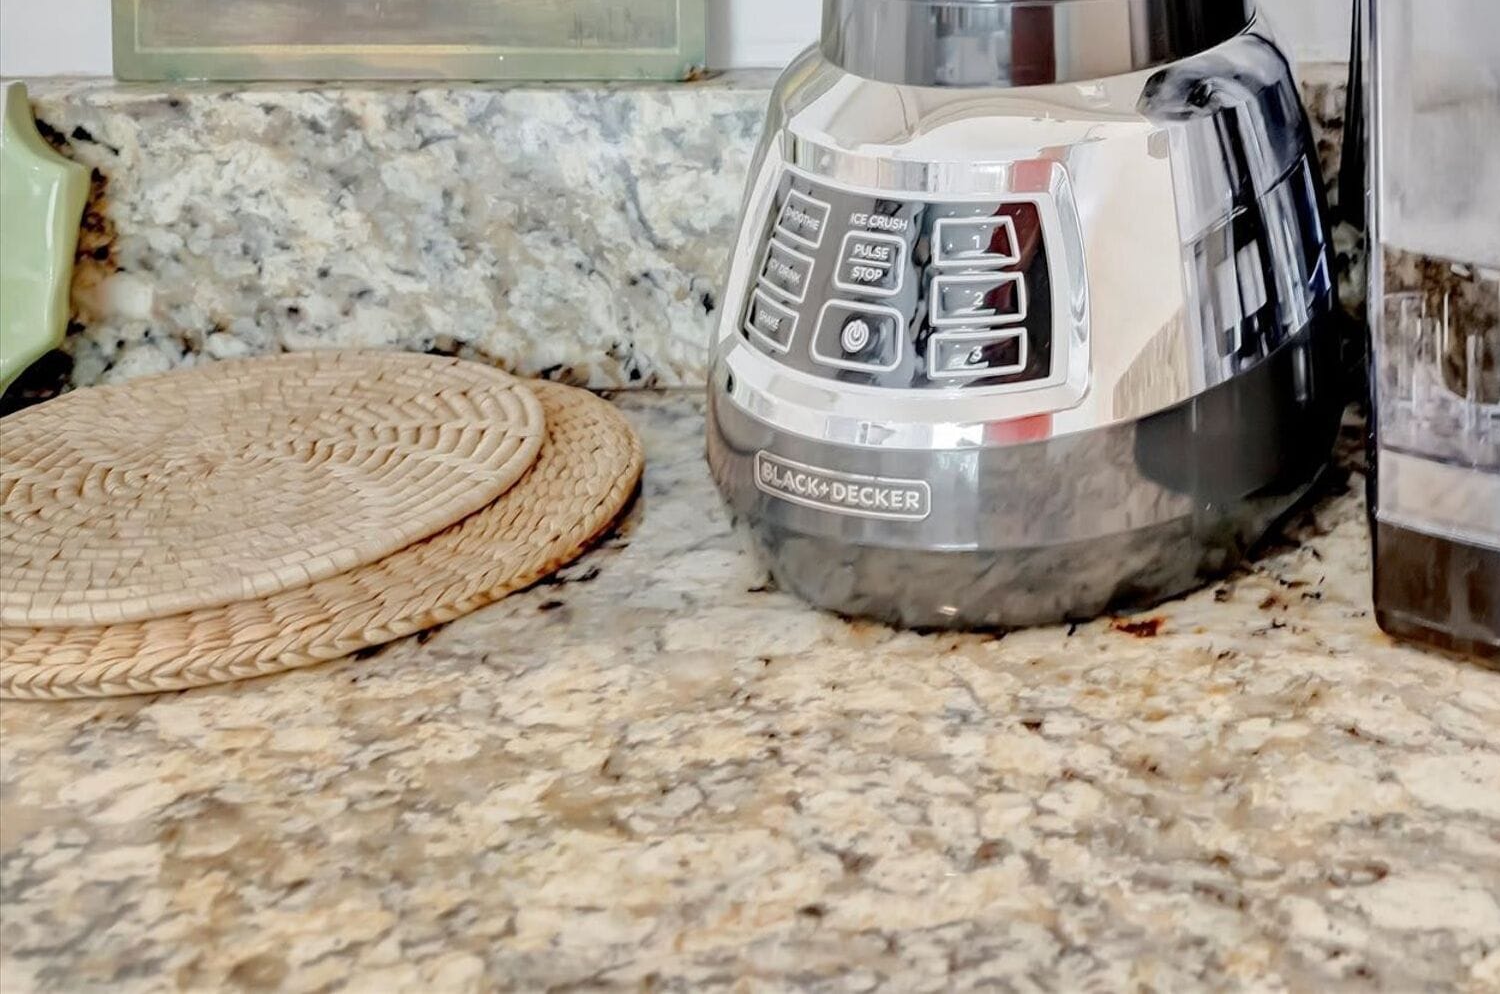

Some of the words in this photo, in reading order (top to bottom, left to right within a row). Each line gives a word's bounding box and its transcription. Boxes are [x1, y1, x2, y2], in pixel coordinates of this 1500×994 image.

[785, 206, 821, 231] SMOOTHIE
[849, 212, 867, 226] ICE
[867, 214, 908, 230] CRUSH
[972, 235, 980, 248] 1
[853, 243, 890, 260] PULSE
[778, 264, 801, 284] DRINK
[852, 266, 883, 282] STOP
[974, 292, 984, 306] 2
[758, 309, 780, 331] SHAKE
[971, 347, 983, 363] 3
[761, 462, 920, 509] BLACK+DECKER
